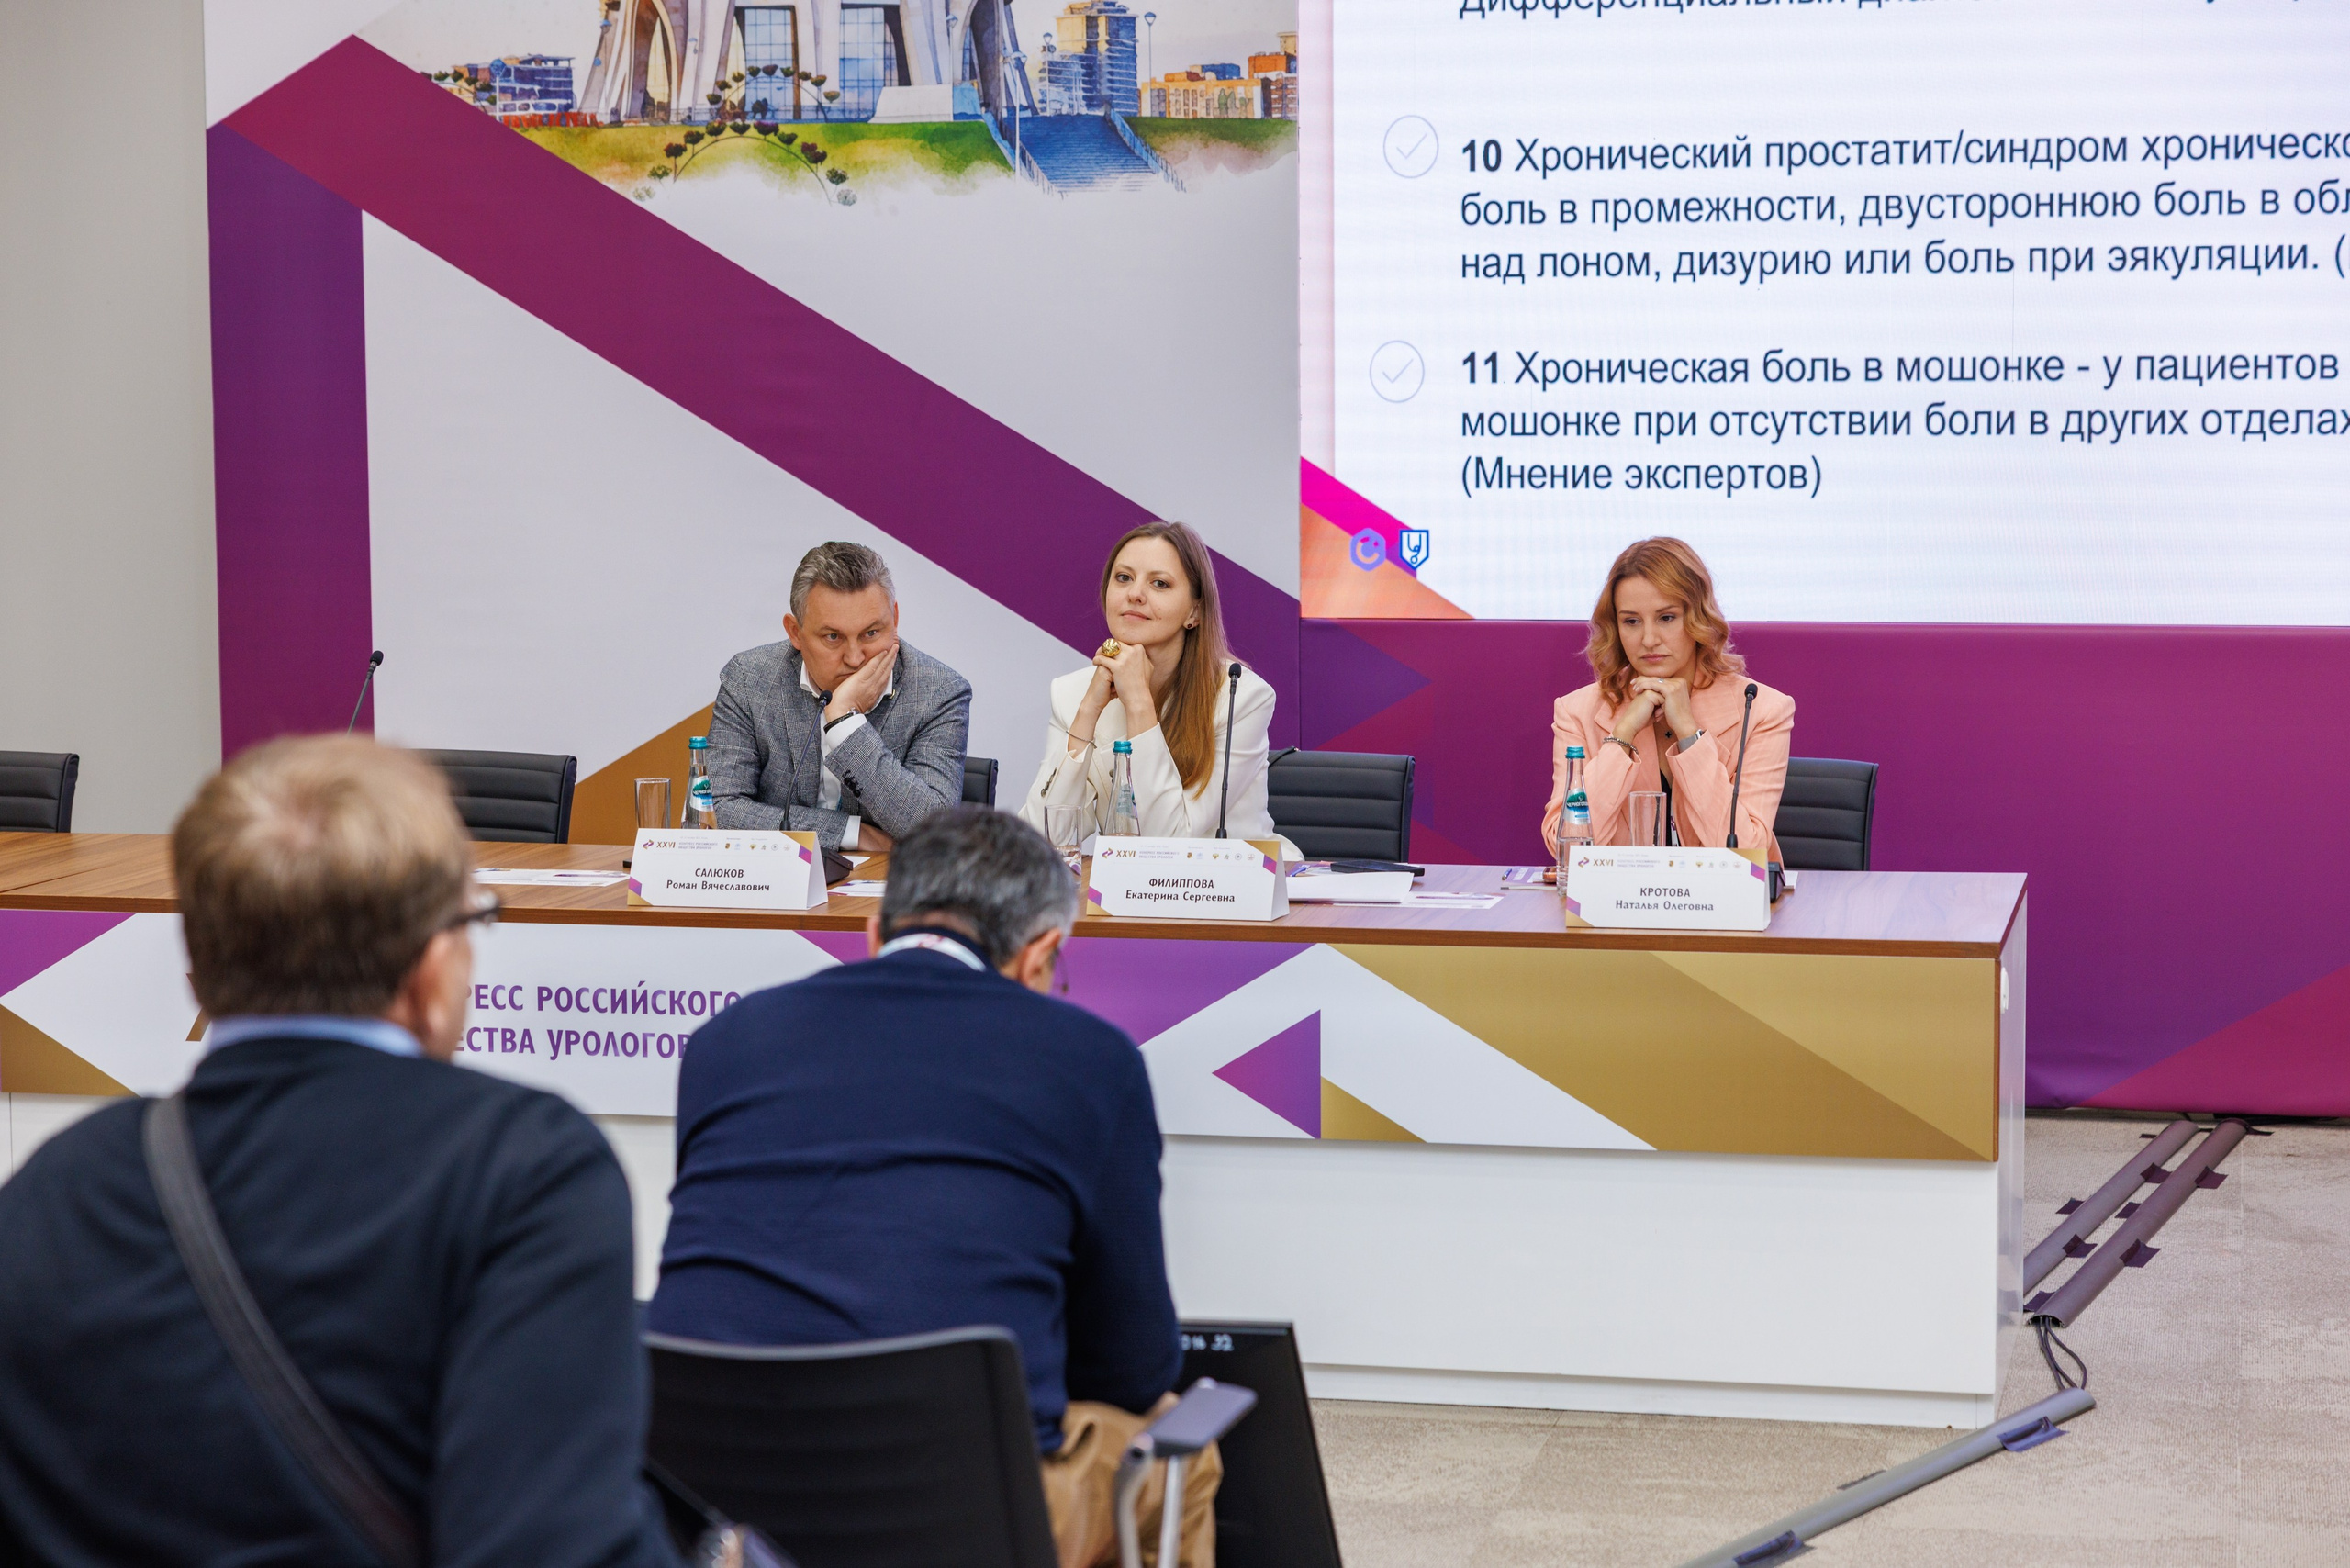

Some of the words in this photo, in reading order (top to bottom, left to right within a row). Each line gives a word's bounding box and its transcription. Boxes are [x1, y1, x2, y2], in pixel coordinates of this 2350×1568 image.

[1462, 140, 1501, 172] 10
[1515, 135, 1751, 179] Хронический
[1766, 130, 2126, 175] простатит/синдром
[1461, 192, 1546, 225] боль
[1561, 200, 1577, 223] в
[1592, 196, 1844, 231] промежности,
[1859, 191, 2140, 229] двустороннюю
[2155, 182, 2245, 216] боль
[2262, 190, 2279, 214] в
[1462, 254, 1525, 284] над
[1537, 252, 1660, 282] лоном,
[1673, 250, 1830, 285] дизурию
[1846, 250, 1909, 274] или
[1925, 239, 2014, 274] боль
[2030, 247, 2093, 280] при
[2109, 245, 2318, 280] эякуляции.
[1463, 352, 1497, 383] 11
[1515, 352, 1748, 392] Хроническая
[1763, 349, 1850, 382] боль
[1865, 358, 1882, 382] в
[1897, 356, 2064, 382] мошонке
[2103, 356, 2122, 390] у
[2137, 354, 2338, 386] пациентов
[1462, 412, 1620, 437] мошонке
[1635, 412, 1695, 444] при
[1710, 411, 1910, 444] отсутствии
[1926, 401, 2014, 436] боли
[2031, 411, 2048, 435] в
[2061, 410, 2188, 444] других
[1462, 456, 1612, 498] (Мнение
[1625, 455, 1820, 498] экспертов)
[655, 841, 676, 849] XXVI
[1115, 849, 1136, 857] XXVI
[1593, 858, 1614, 867] XXVI
[694, 868, 744, 879] САЛЮКОВ
[666, 879, 698, 890] Роман
[701, 880, 770, 891] Вячеславович
[1148, 878, 1214, 889] ФИЛИППОВА
[1125, 890, 1179, 902] Екатерина
[1182, 890, 1236, 904] Сергеевна
[1639, 887, 1691, 897] КРОТОВА
[1616, 900, 1659, 910] Наталья
[1663, 901, 1714, 911] Олеговна
